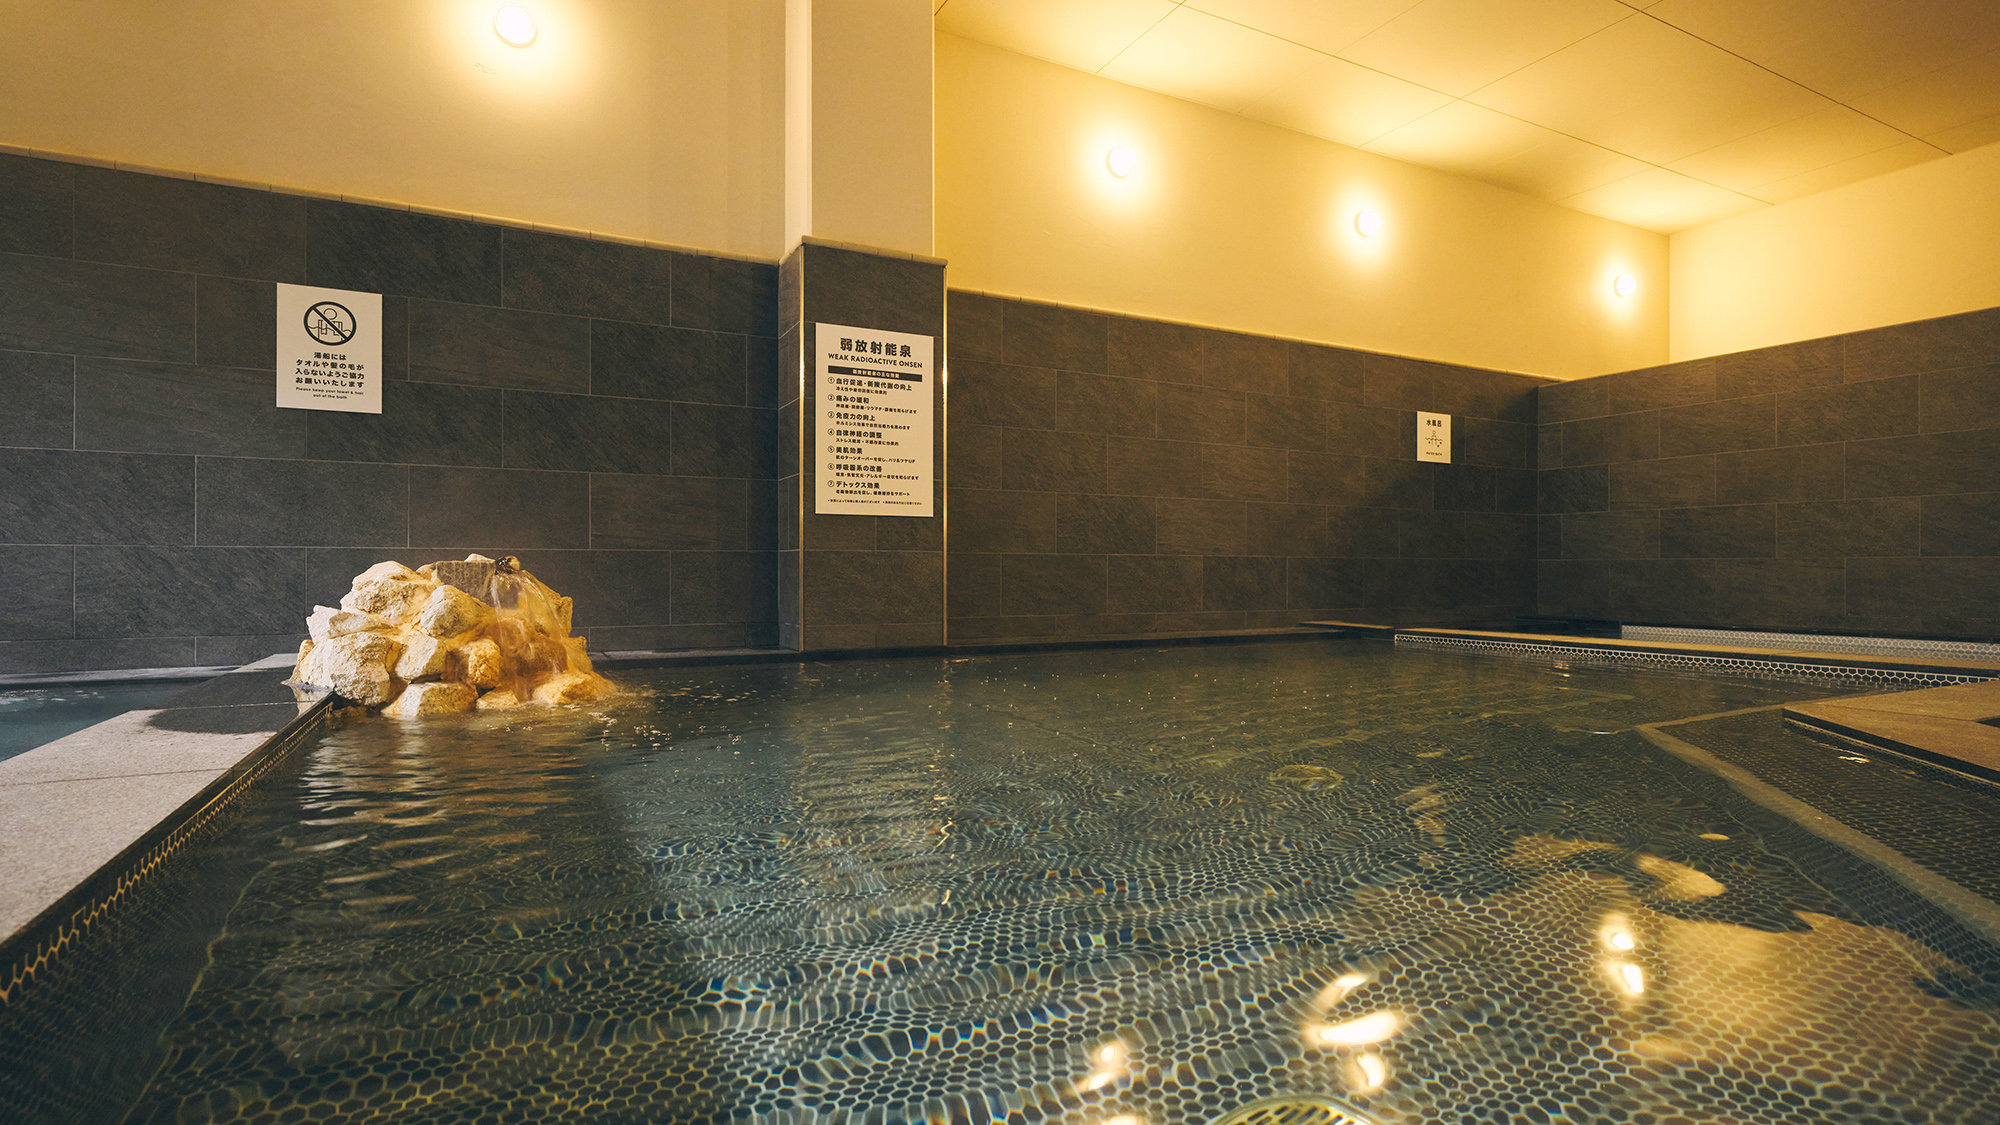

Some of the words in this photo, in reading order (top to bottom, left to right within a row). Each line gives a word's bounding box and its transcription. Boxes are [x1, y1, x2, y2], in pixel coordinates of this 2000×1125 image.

[840, 337, 912, 358] 弱放射能泉
[314, 352, 346, 360] 湯船には
[828, 352, 849, 361] WEAK
[851, 355, 897, 367] RADIOACTIVE
[899, 360, 923, 369] ONSEN
[296, 359, 364, 371] タオルや髪の毛が
[295, 368, 364, 380] 入らないようご協力
[295, 377, 364, 388] お願いいたします
[1426, 419, 1442, 427] 水風呂
